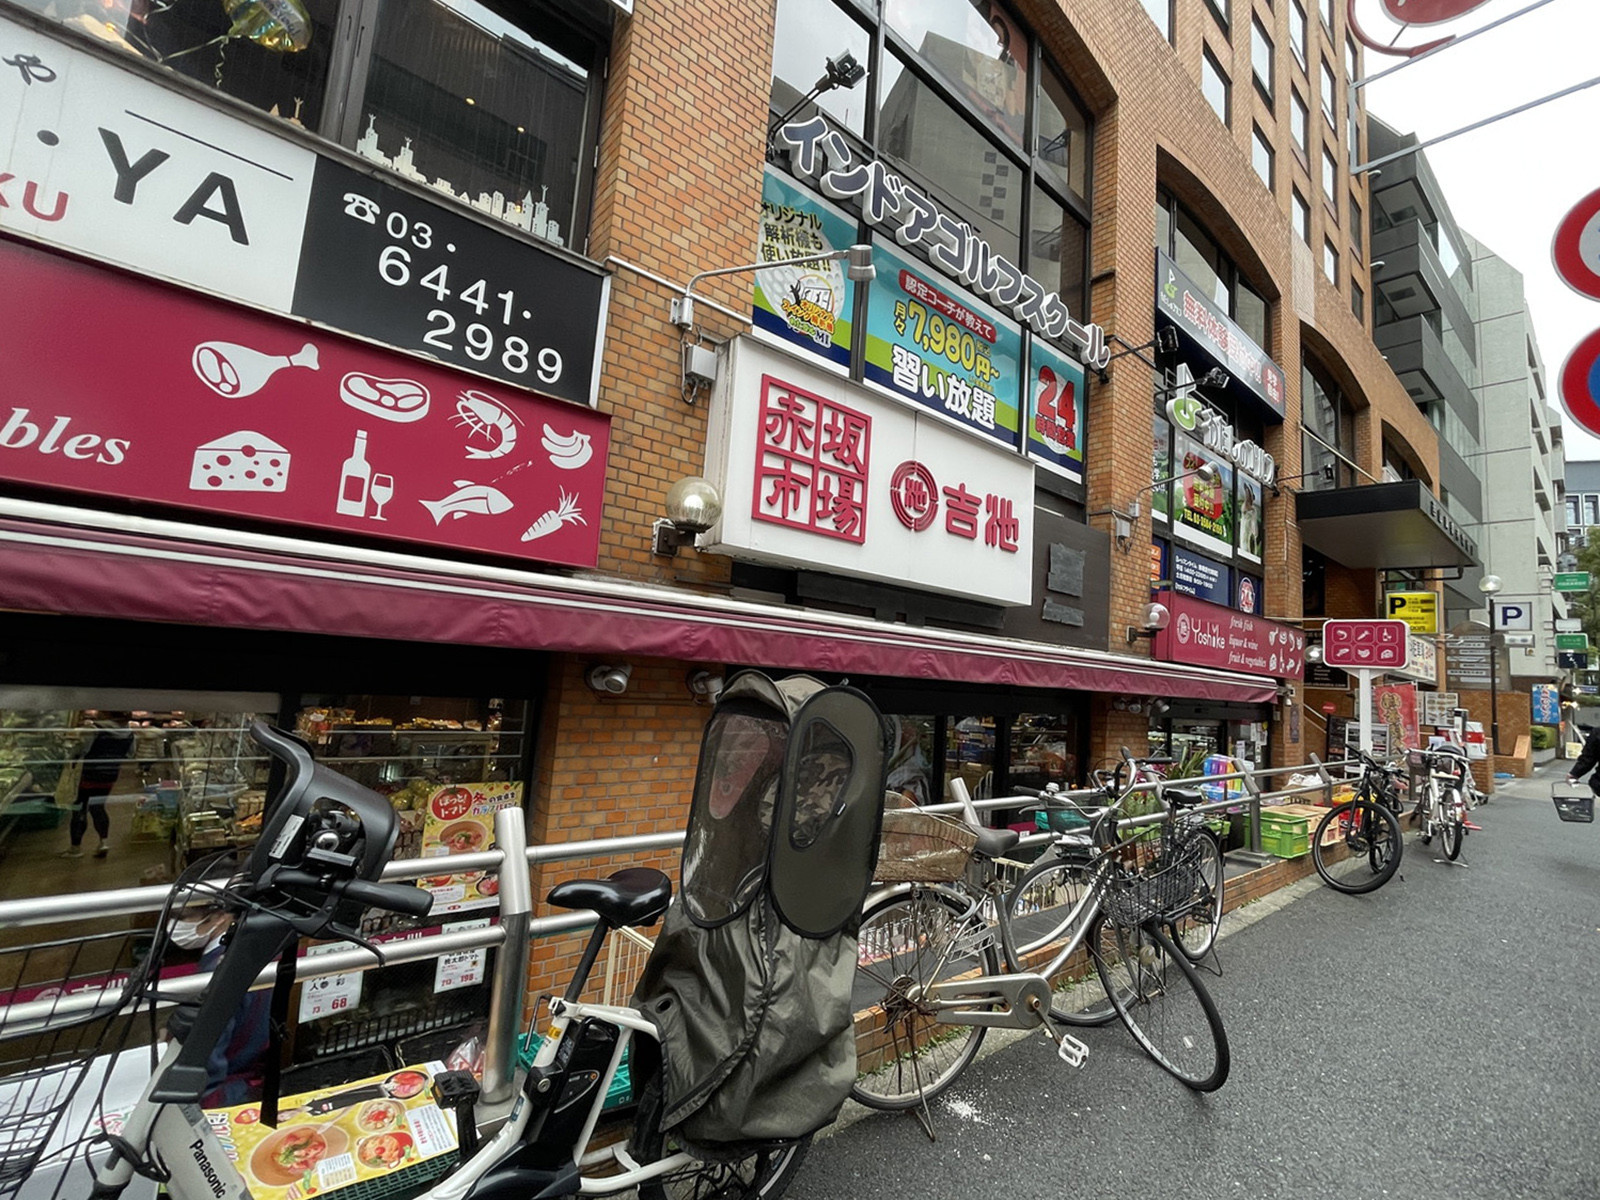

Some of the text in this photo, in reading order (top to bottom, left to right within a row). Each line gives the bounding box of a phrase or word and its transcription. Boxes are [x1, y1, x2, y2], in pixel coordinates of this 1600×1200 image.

[760, 201, 822, 230] オリジナル
[781, 114, 1111, 369] インドアゴルフスクール
[904, 274, 993, 340] 認定コーチが教えて
[423, 309, 563, 384] 2989
[891, 343, 996, 430] 習い放題
[1038, 365, 1076, 430] 24
[943, 482, 1019, 552] 吉池
[1390, 597, 1406, 614] P
[1502, 606, 1522, 626] P
[440, 806, 467, 818] トマト
[332, 997, 347, 1010] 68
[189, 1138, 227, 1199] Panasonic
